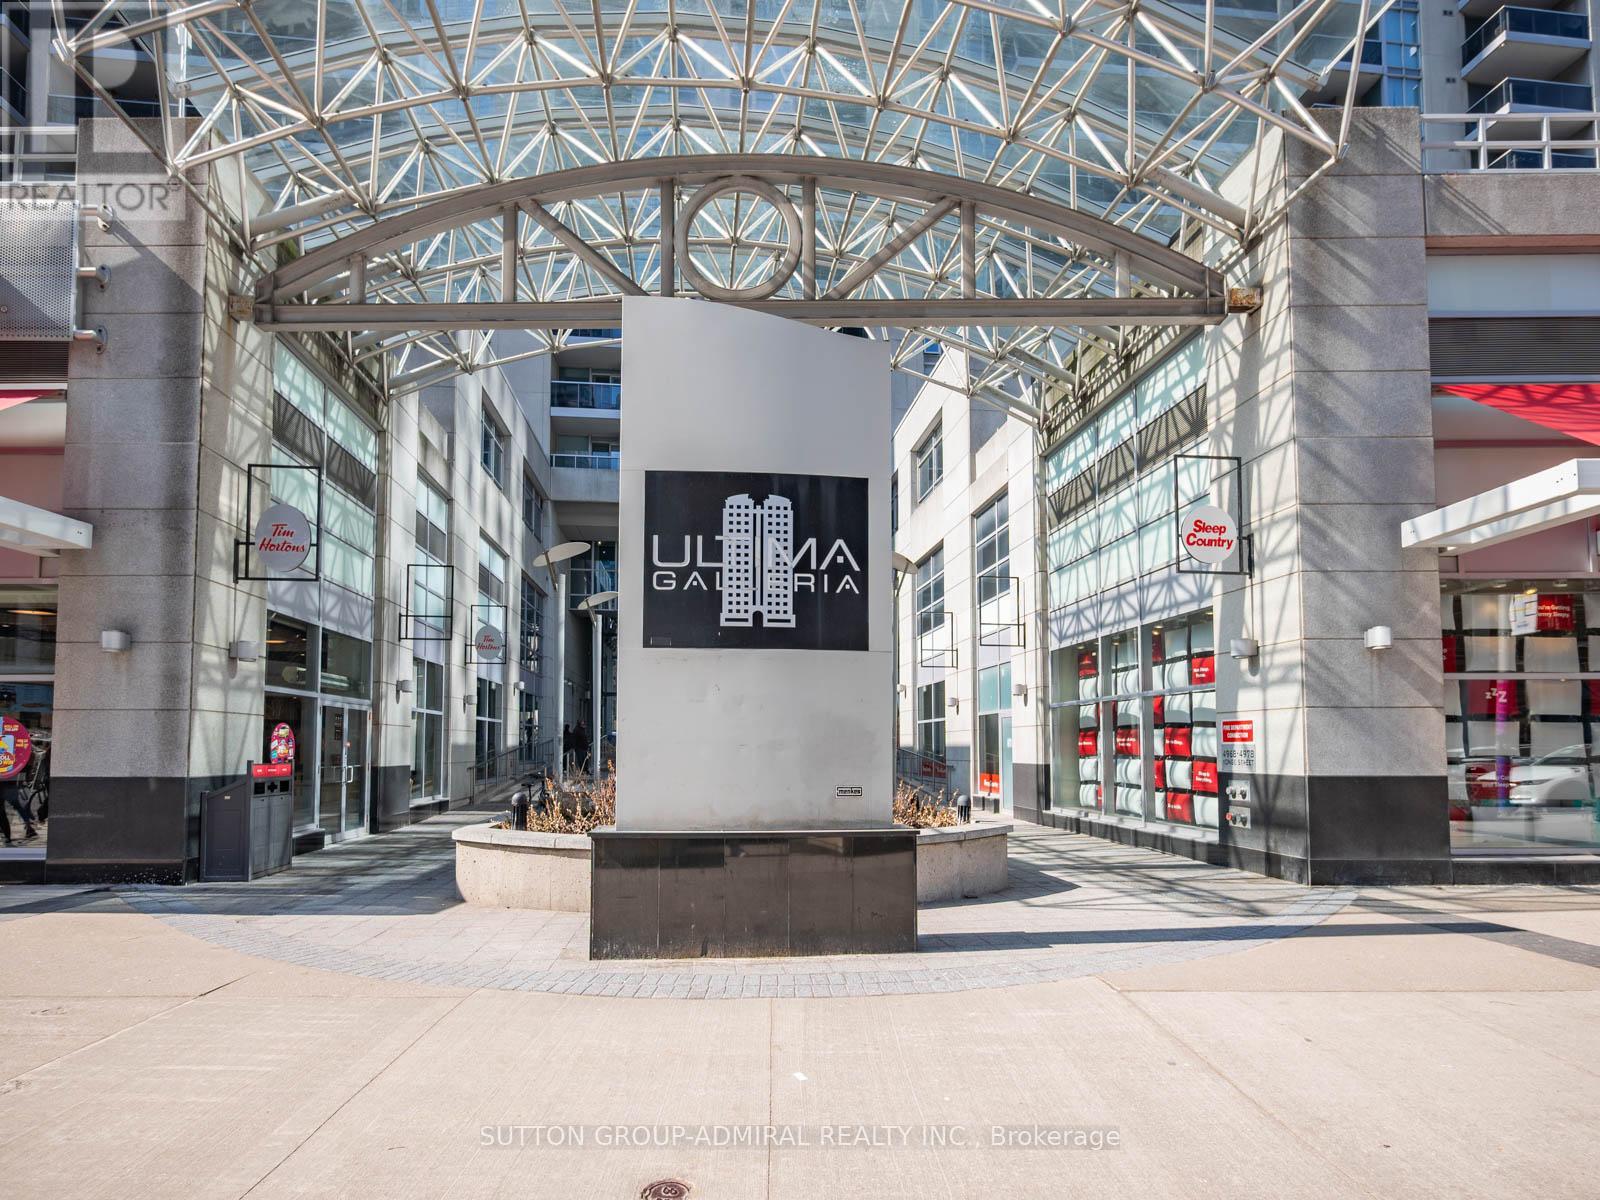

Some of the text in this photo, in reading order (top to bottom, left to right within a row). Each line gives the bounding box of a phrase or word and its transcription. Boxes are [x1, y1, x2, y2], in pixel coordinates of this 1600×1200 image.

[272, 523, 295, 537] Tim
[1193, 519, 1227, 536] Sleep
[258, 537, 305, 553] Hortons
[1186, 532, 1234, 550] Country
[652, 534, 861, 572] ULTIMA
